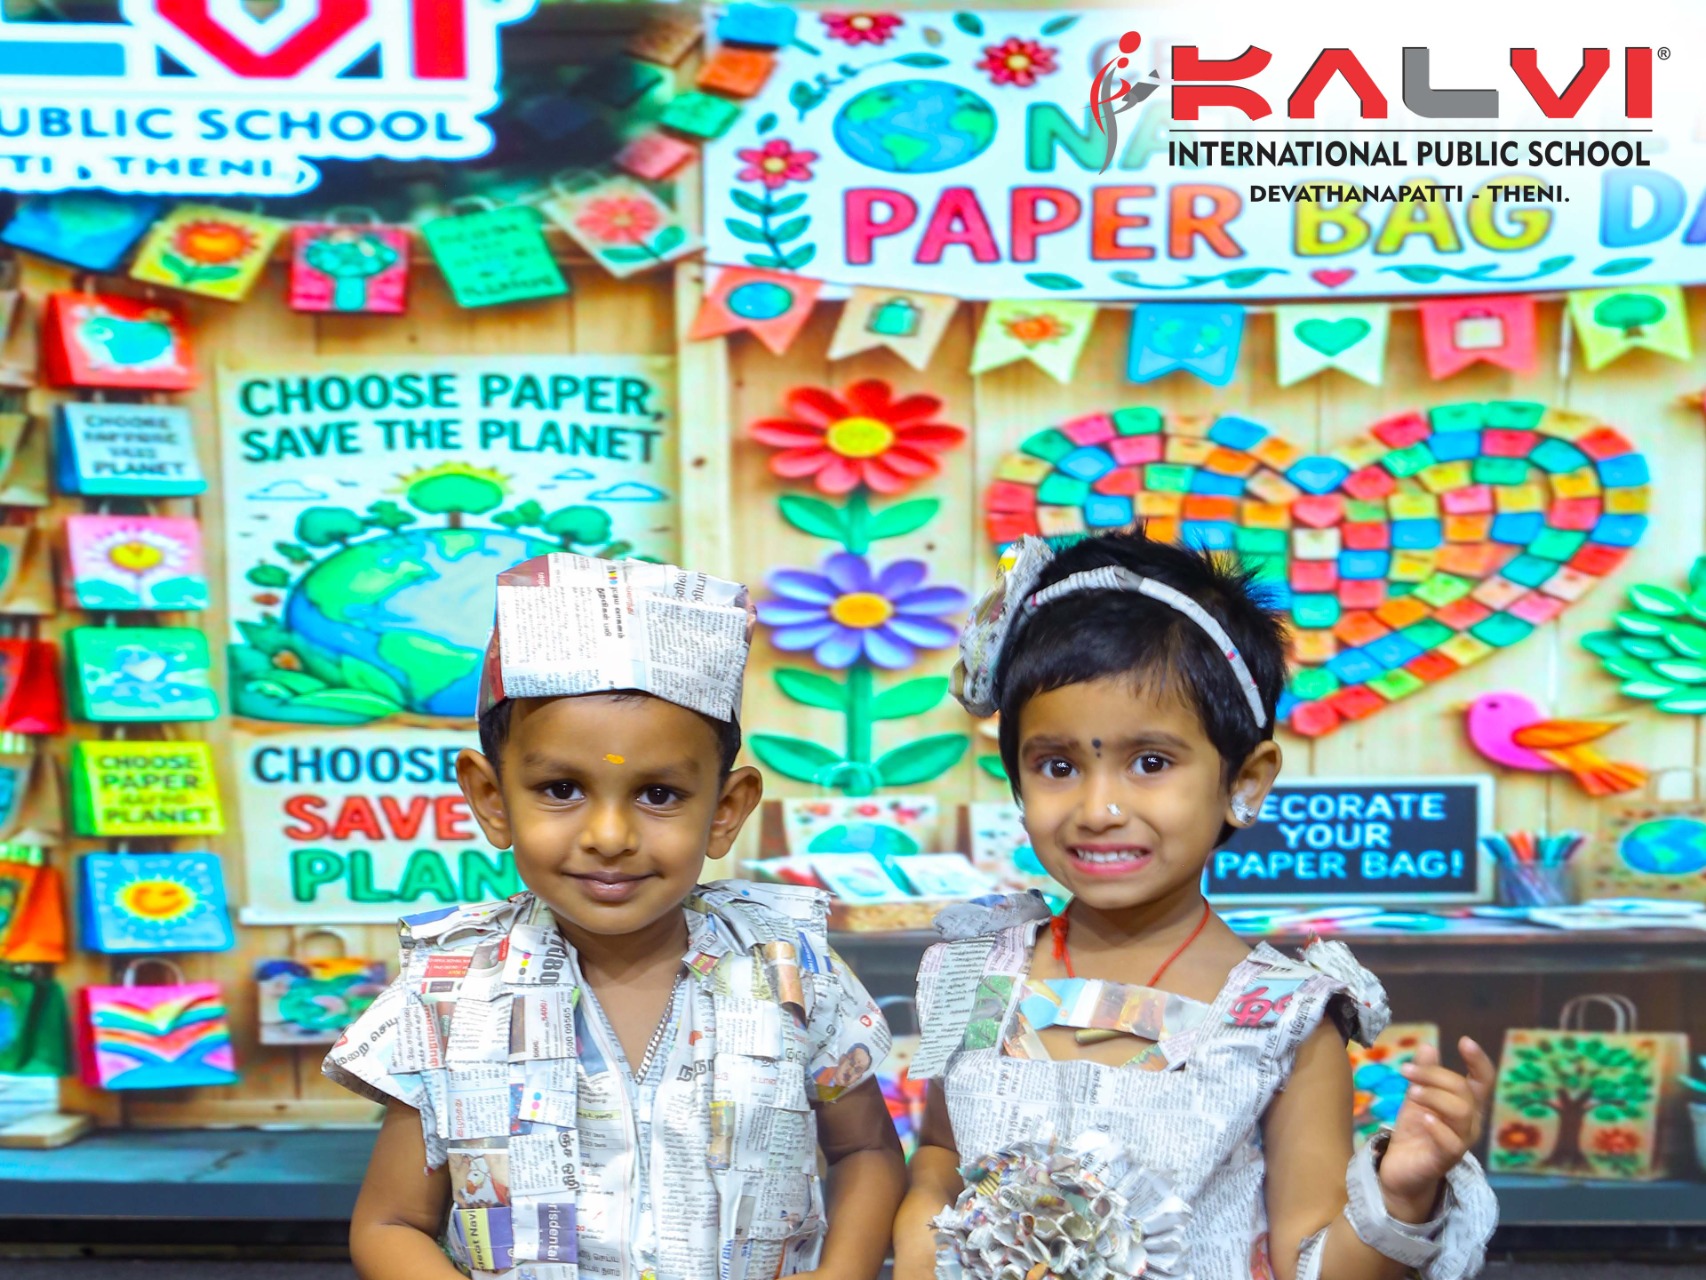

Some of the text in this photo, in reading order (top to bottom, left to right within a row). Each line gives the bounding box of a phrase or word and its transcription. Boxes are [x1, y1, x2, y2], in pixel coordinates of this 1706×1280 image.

[0, 107, 465, 142] UBLIC SCHOOL
[843, 184, 1247, 266] PAPER
[1291, 172, 1556, 258] BAG
[239, 373, 667, 422] CHOOSE PAPER,
[242, 419, 663, 462] SAVE THE PLANET
[102, 774, 200, 789] PAPER
[284, 796, 474, 842] SAVE
[1260, 793, 1447, 823] ECORATE
[1279, 823, 1391, 850] YOUR
[291, 849, 521, 903] PLAN
[1215, 849, 1464, 880] PAPER BAG!
